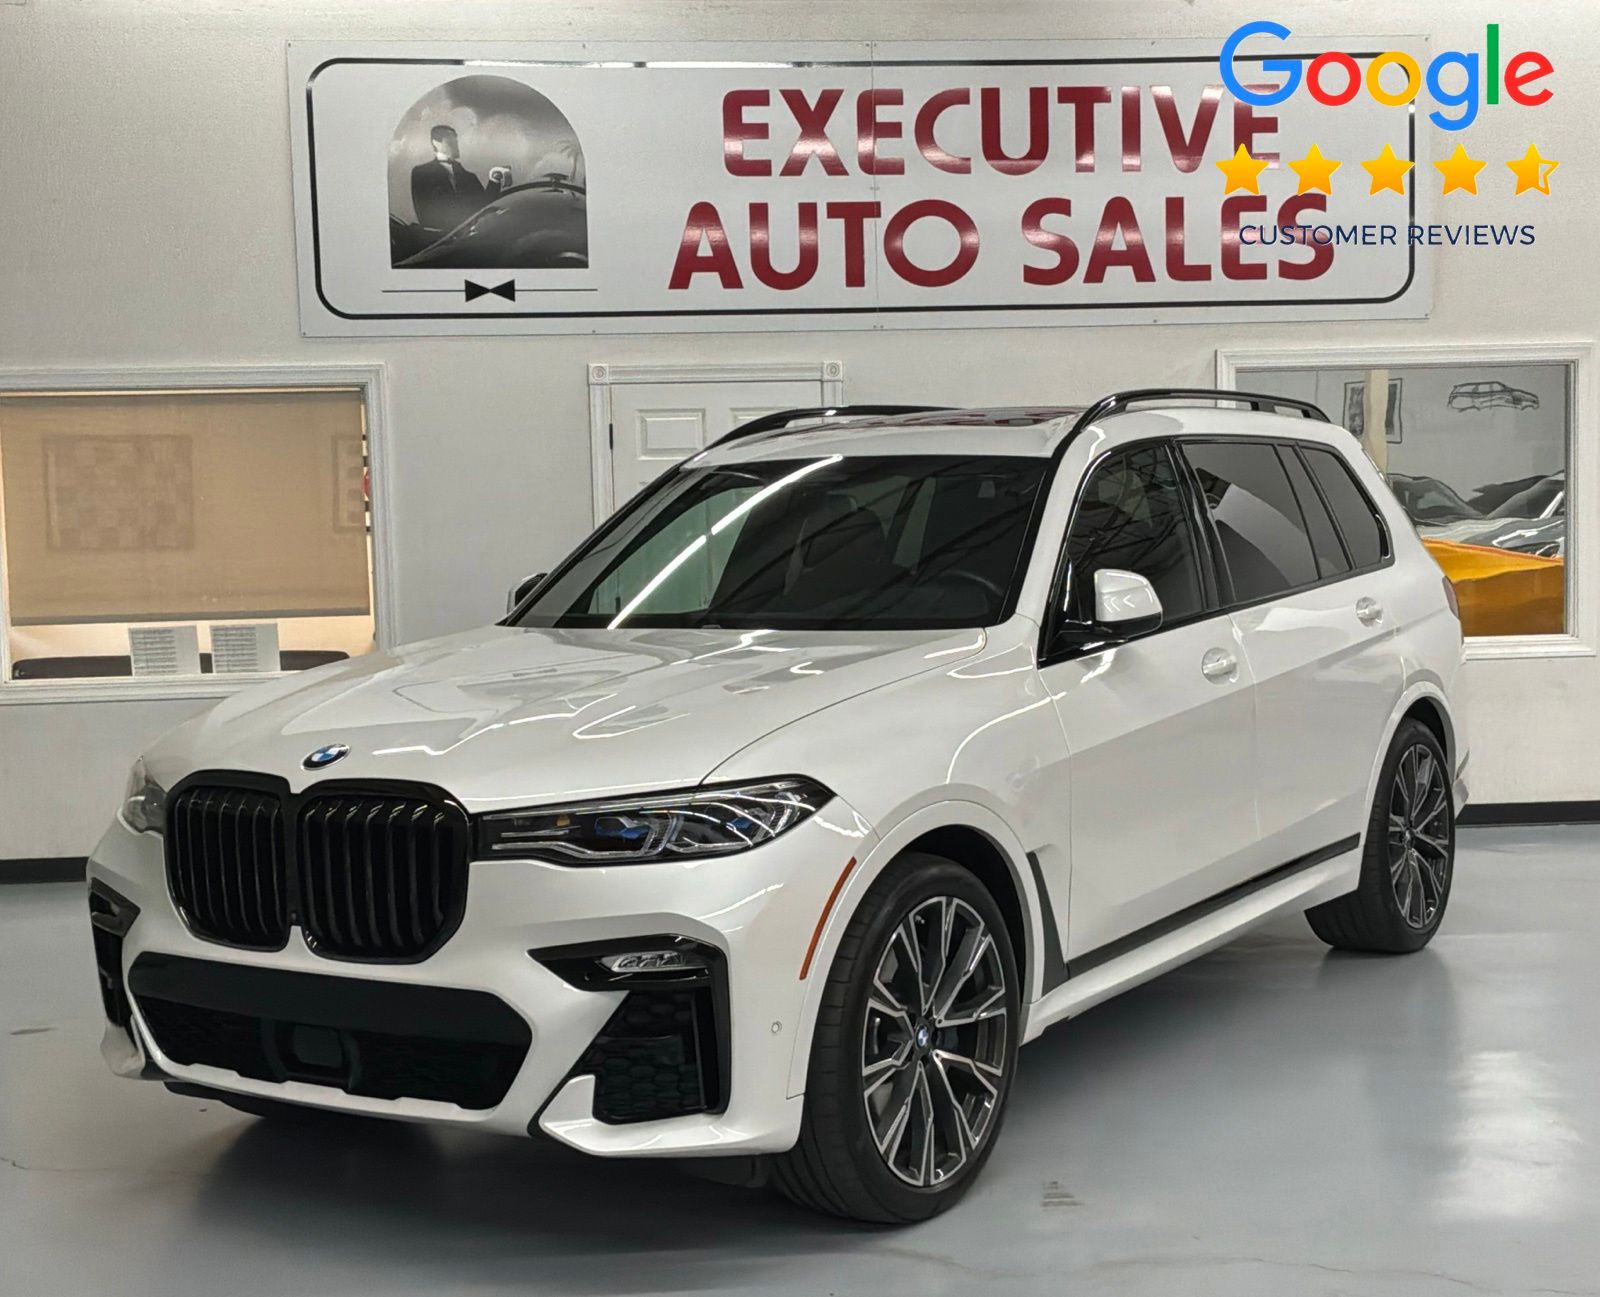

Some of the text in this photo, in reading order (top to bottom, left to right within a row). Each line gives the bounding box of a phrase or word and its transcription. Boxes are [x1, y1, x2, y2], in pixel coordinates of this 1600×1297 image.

[723, 84, 1280, 175] EXECUTIVE
[668, 193, 1334, 290] AUTO SALES
